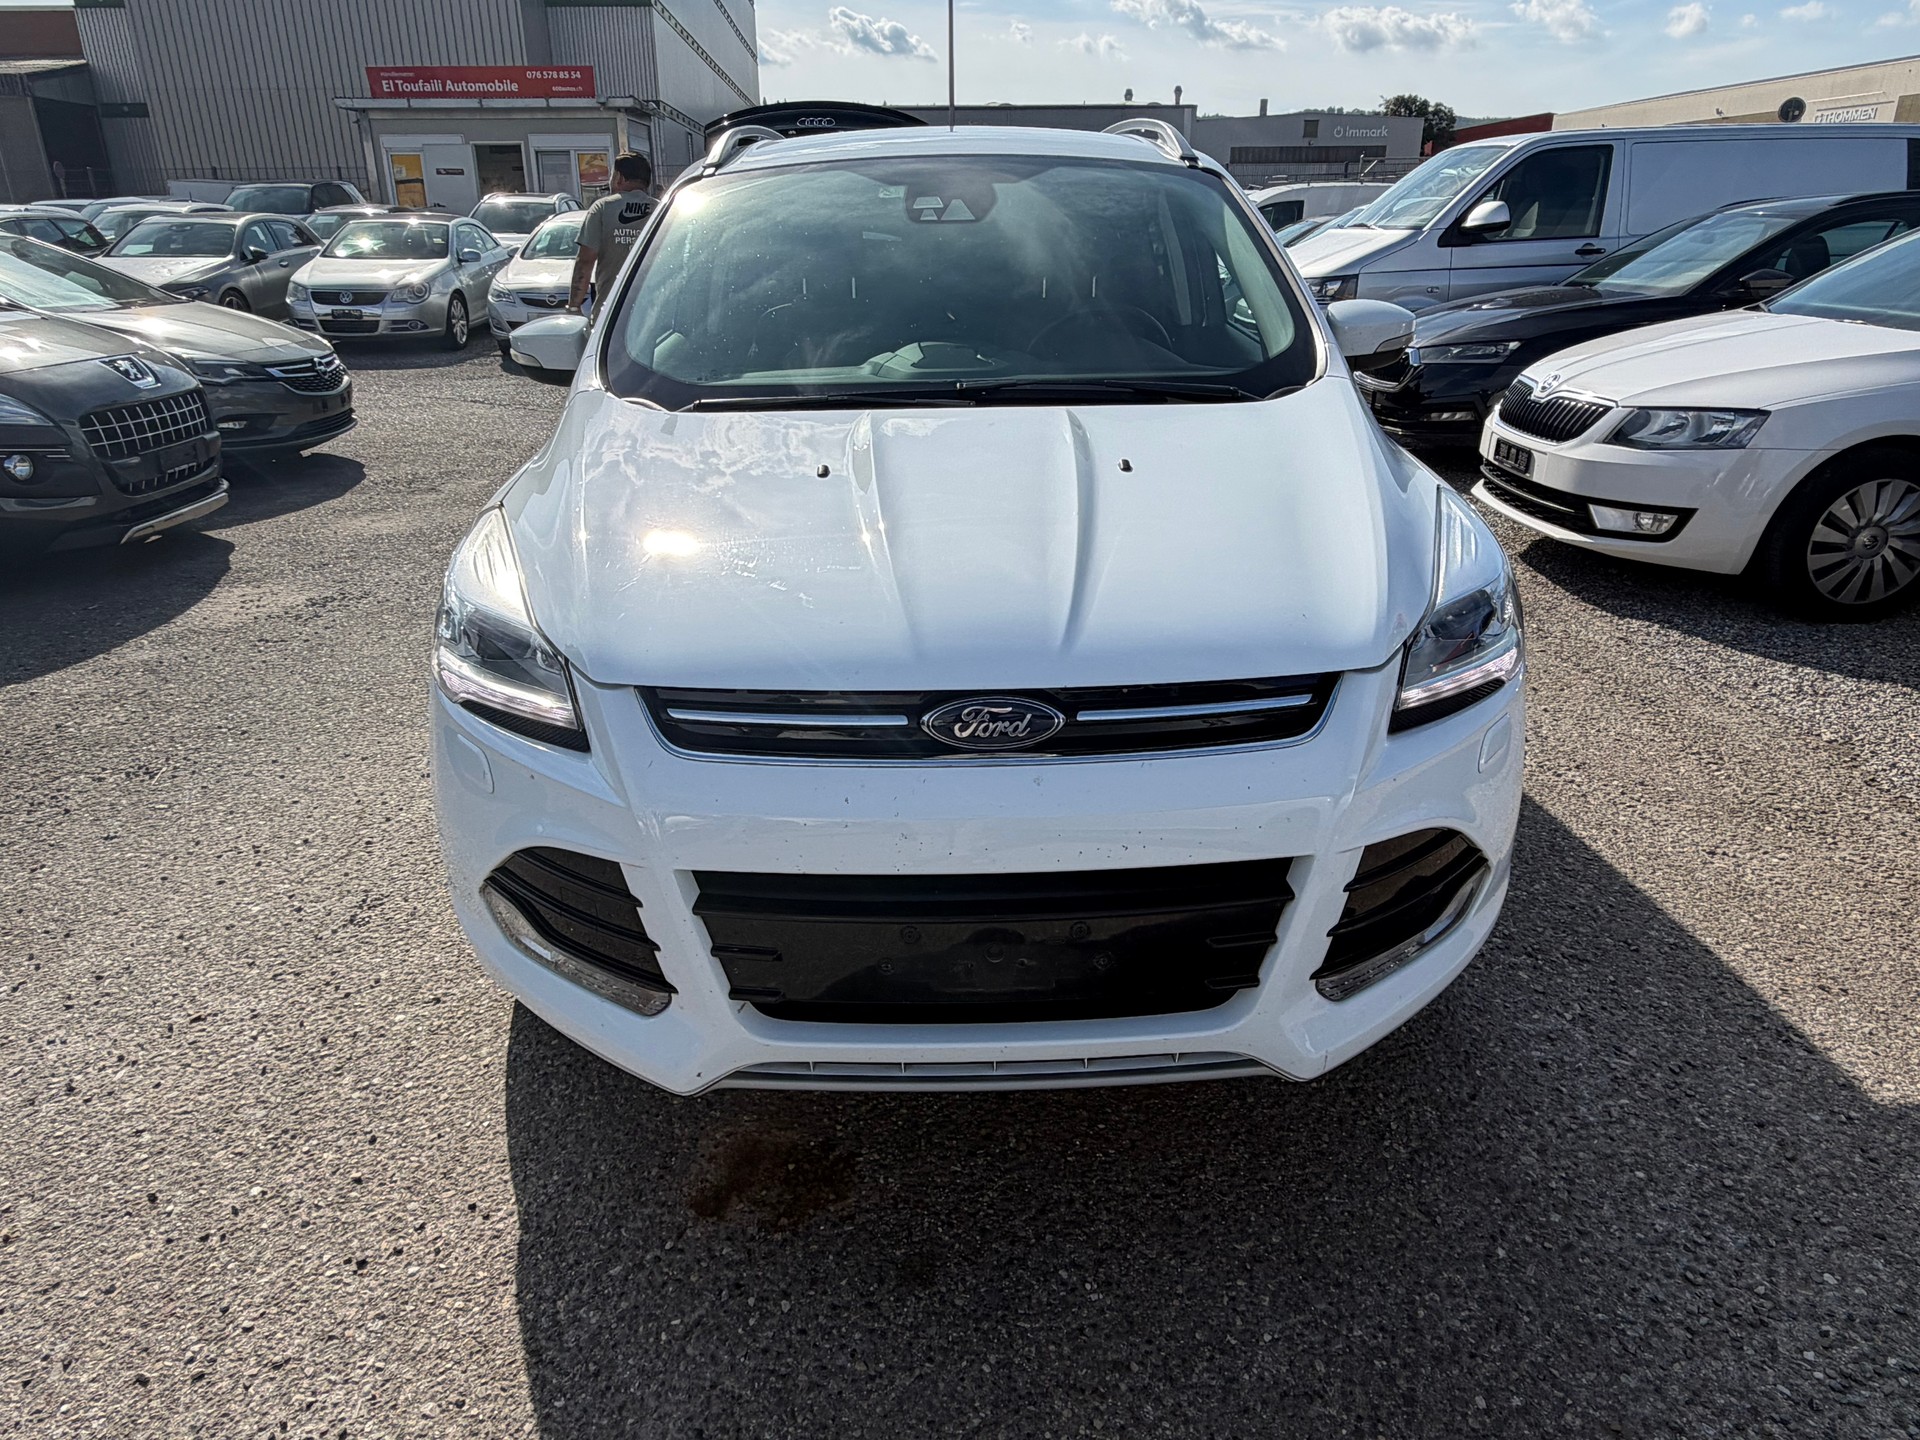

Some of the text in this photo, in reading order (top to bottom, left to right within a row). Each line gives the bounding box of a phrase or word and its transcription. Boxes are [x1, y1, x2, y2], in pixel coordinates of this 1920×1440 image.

[526, 71, 582, 79] 076 578 85 54
[382, 80, 519, 92] El Toufaili Automobile
[1346, 125, 1388, 137] Immark
[624, 202, 651, 215] NIKE
[954, 706, 1032, 738] Ford
